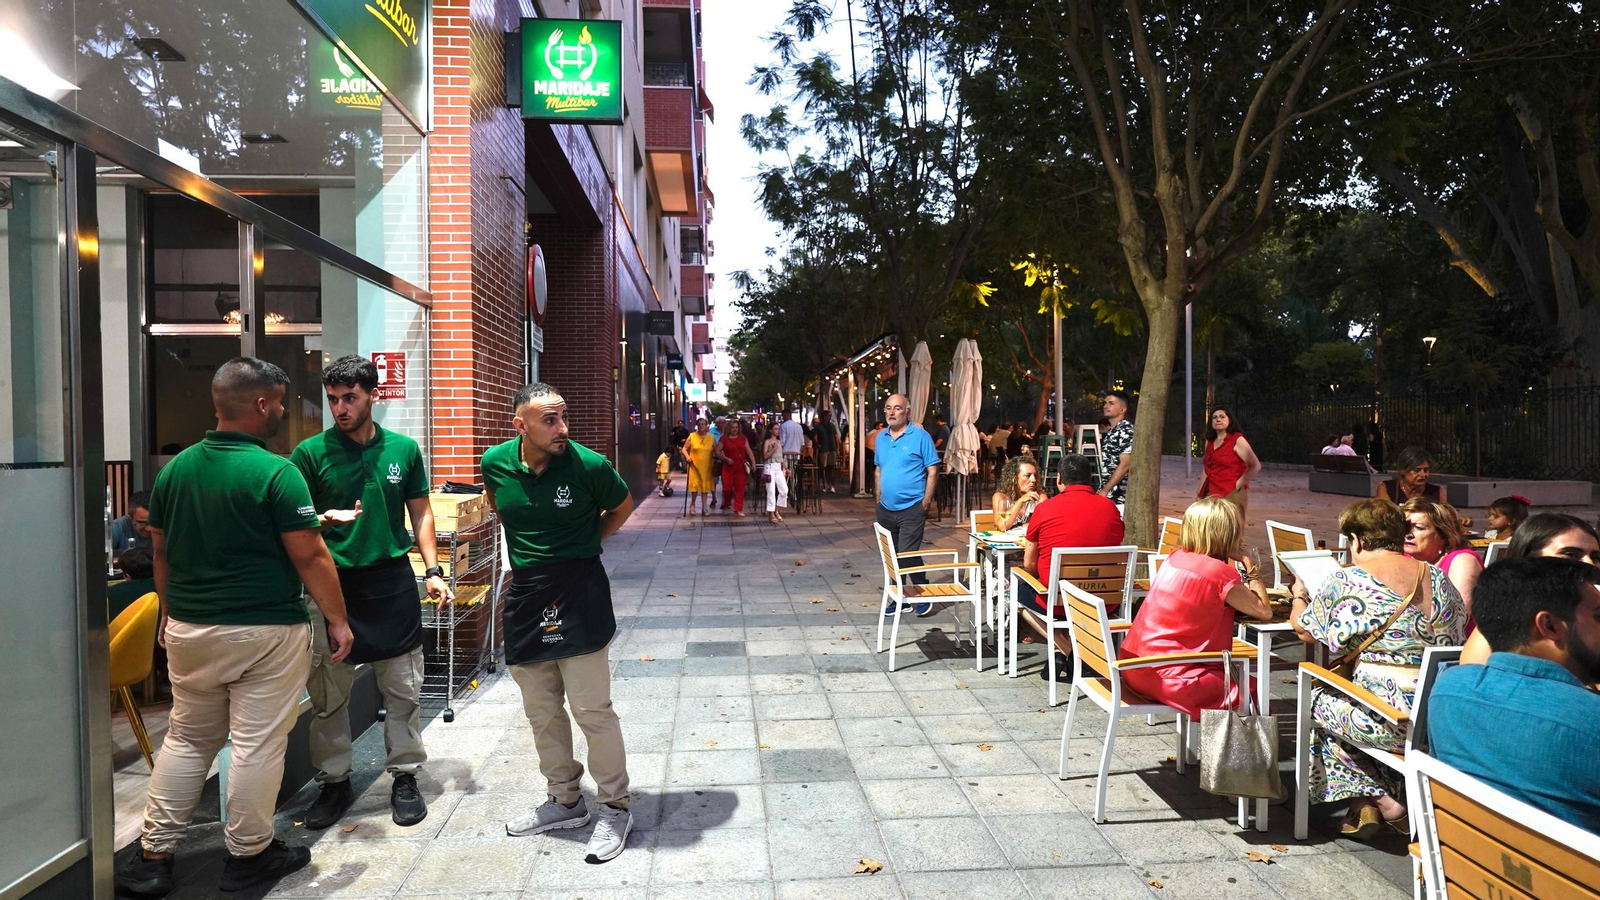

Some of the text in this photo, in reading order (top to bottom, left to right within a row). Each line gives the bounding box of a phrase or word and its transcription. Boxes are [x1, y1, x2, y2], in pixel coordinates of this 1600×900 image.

[534, 80, 610, 97] MARIDAJE
[545, 96, 598, 109] Multibar
[1077, 582, 1107, 590] TURIA
